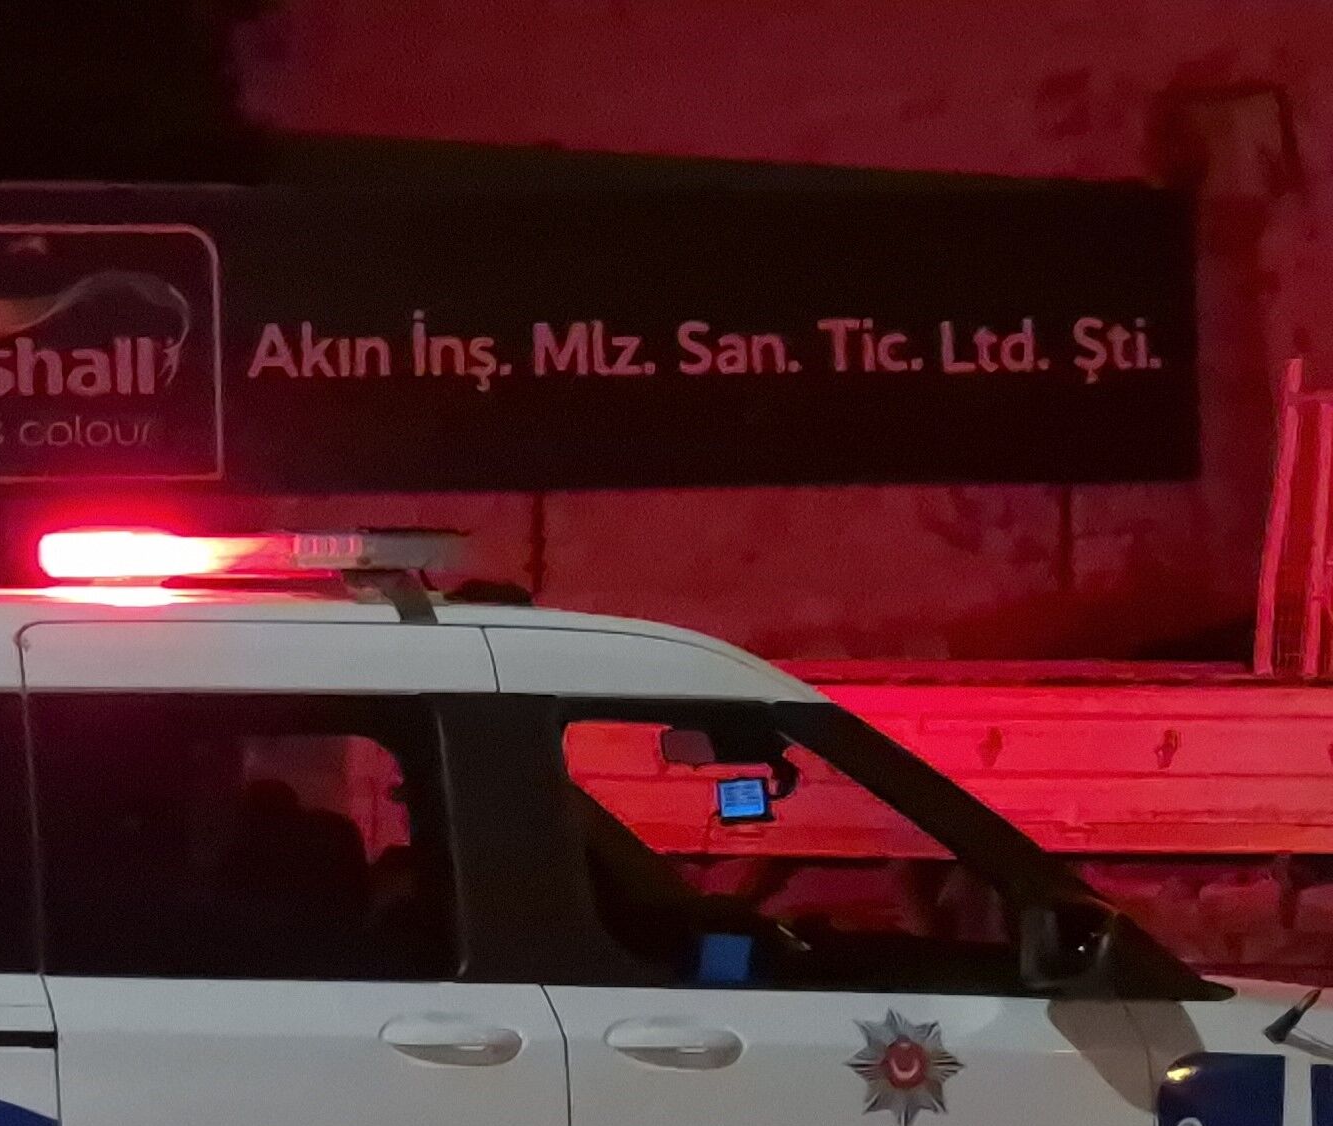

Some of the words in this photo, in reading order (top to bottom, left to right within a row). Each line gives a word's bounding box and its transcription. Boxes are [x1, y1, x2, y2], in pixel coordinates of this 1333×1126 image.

[247, 321, 391, 377] Akın
[412, 309, 513, 392] İnş.
[533, 320, 656, 376] Mlz.
[676, 319, 803, 375] San.
[817, 317, 925, 373] Tic.
[939, 317, 1051, 373] Ltd.
[1072, 316, 1162, 385] Şti.
[18, 415, 154, 448] colour
